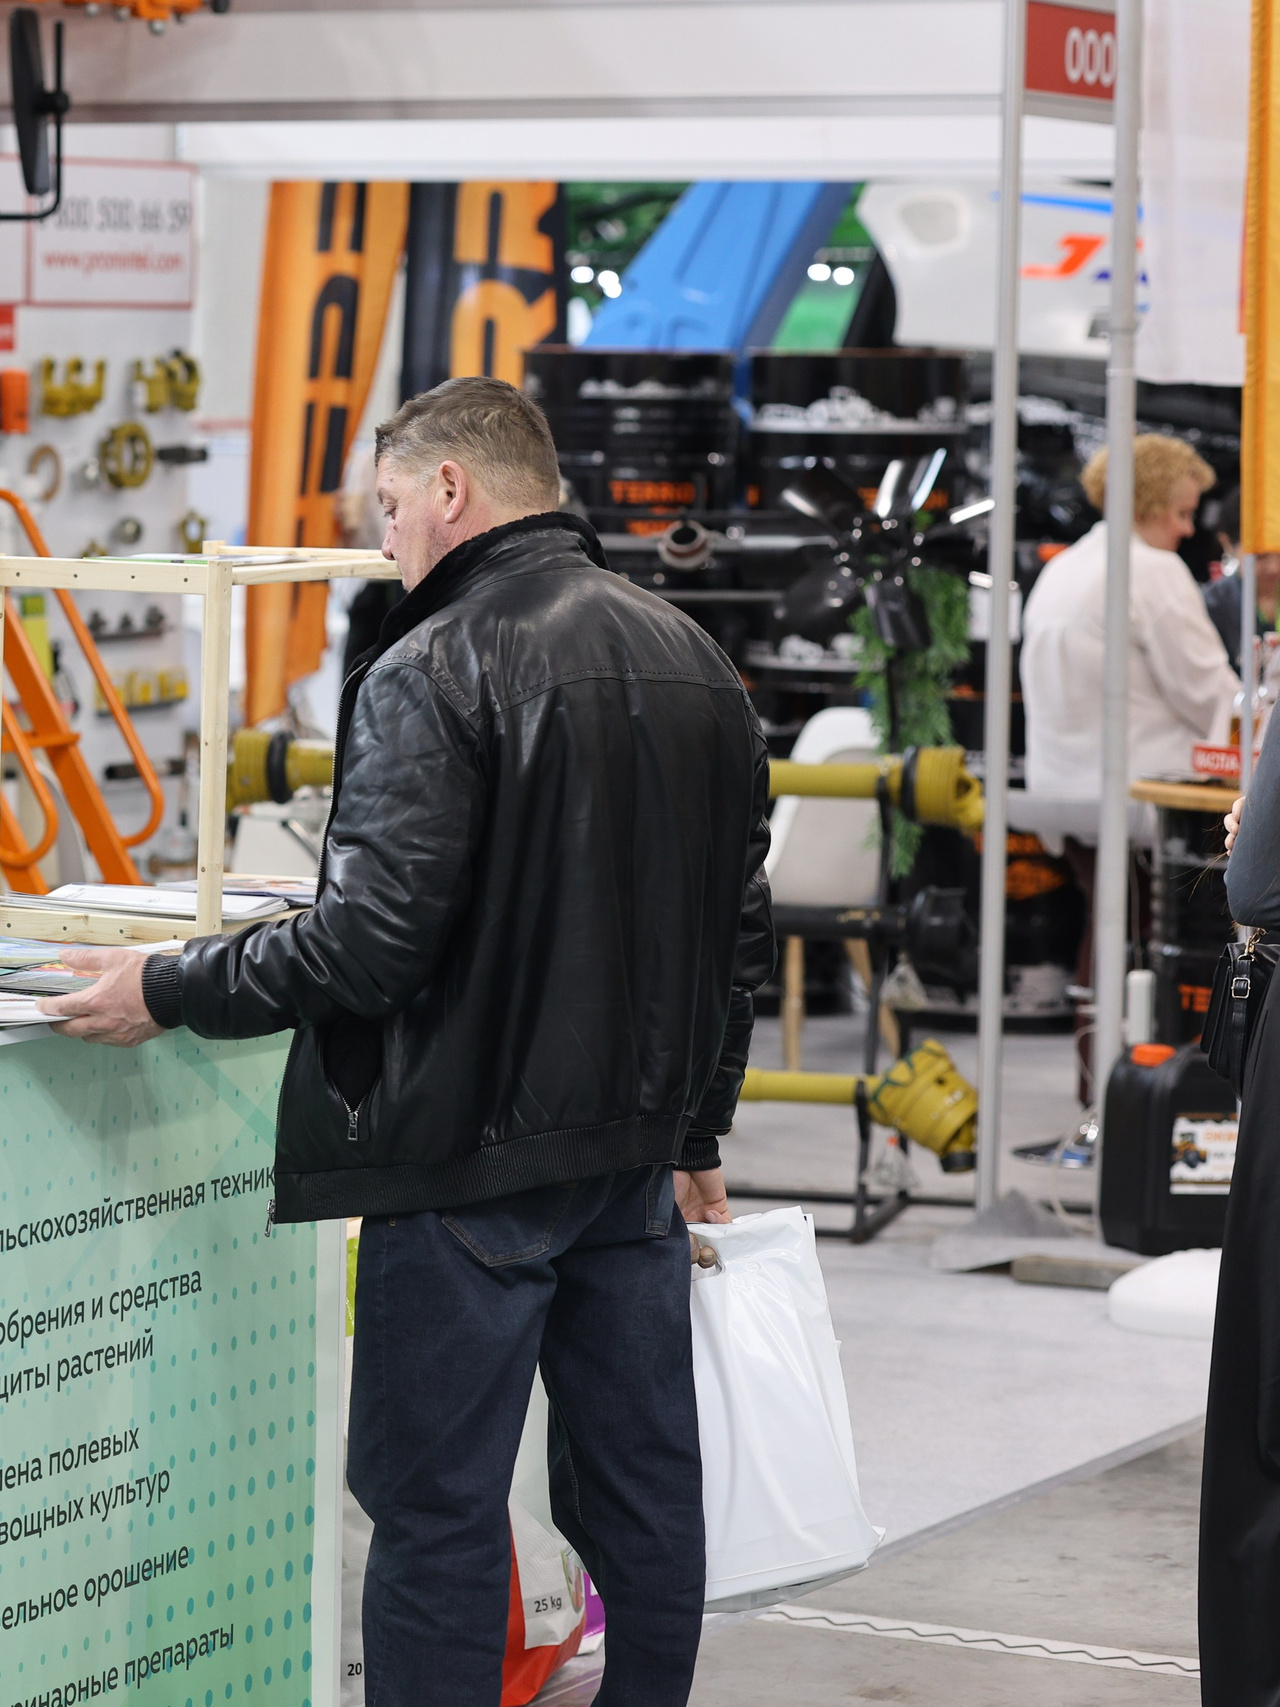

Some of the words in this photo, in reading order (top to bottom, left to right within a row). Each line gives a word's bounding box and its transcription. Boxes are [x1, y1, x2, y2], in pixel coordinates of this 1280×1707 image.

[211, 1166, 276, 1201] техник
[92, 1295, 103, 1320] и
[109, 1270, 203, 1322] средства
[58, 1328, 154, 1393] растений
[49, 1427, 140, 1476] полевых
[90, 1470, 170, 1523] культур
[85, 1545, 190, 1608] орошение
[534, 1598, 548, 1613] 25
[551, 1595, 562, 1611] kg
[124, 1623, 235, 1690] препараты
